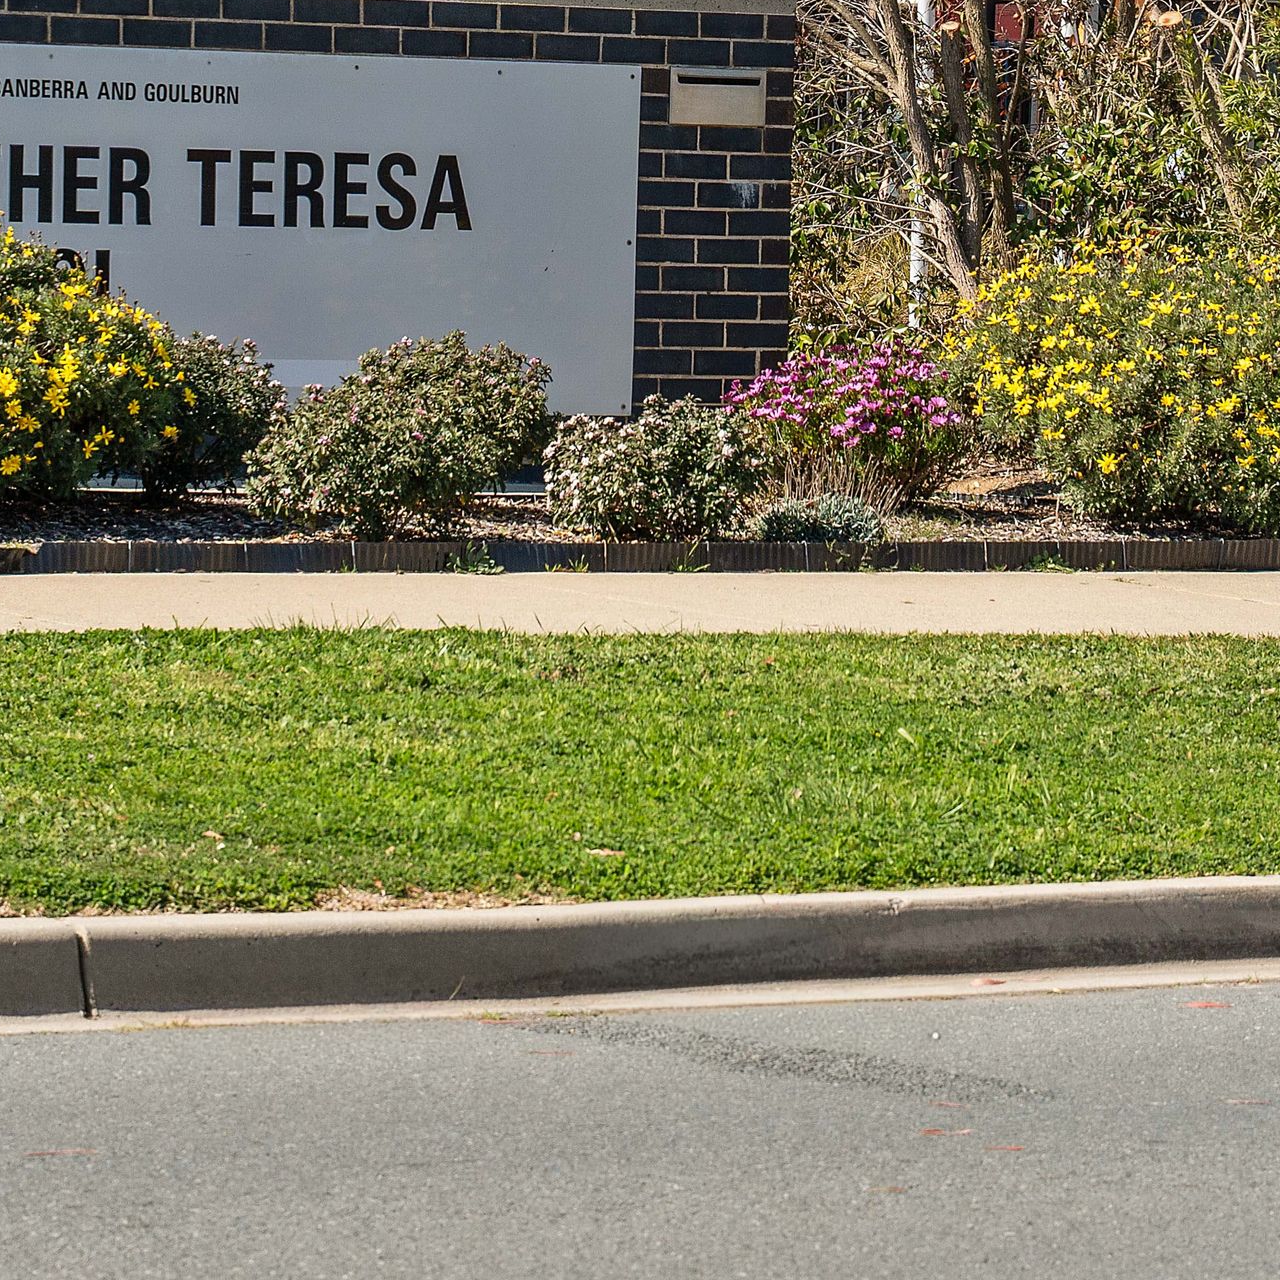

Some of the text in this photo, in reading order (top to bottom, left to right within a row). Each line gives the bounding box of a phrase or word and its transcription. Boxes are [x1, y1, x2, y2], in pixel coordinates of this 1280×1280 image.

[97, 81, 137, 101] AND
[144, 82, 239, 105] GOULBURN
[186, 148, 473, 231] TERESA
